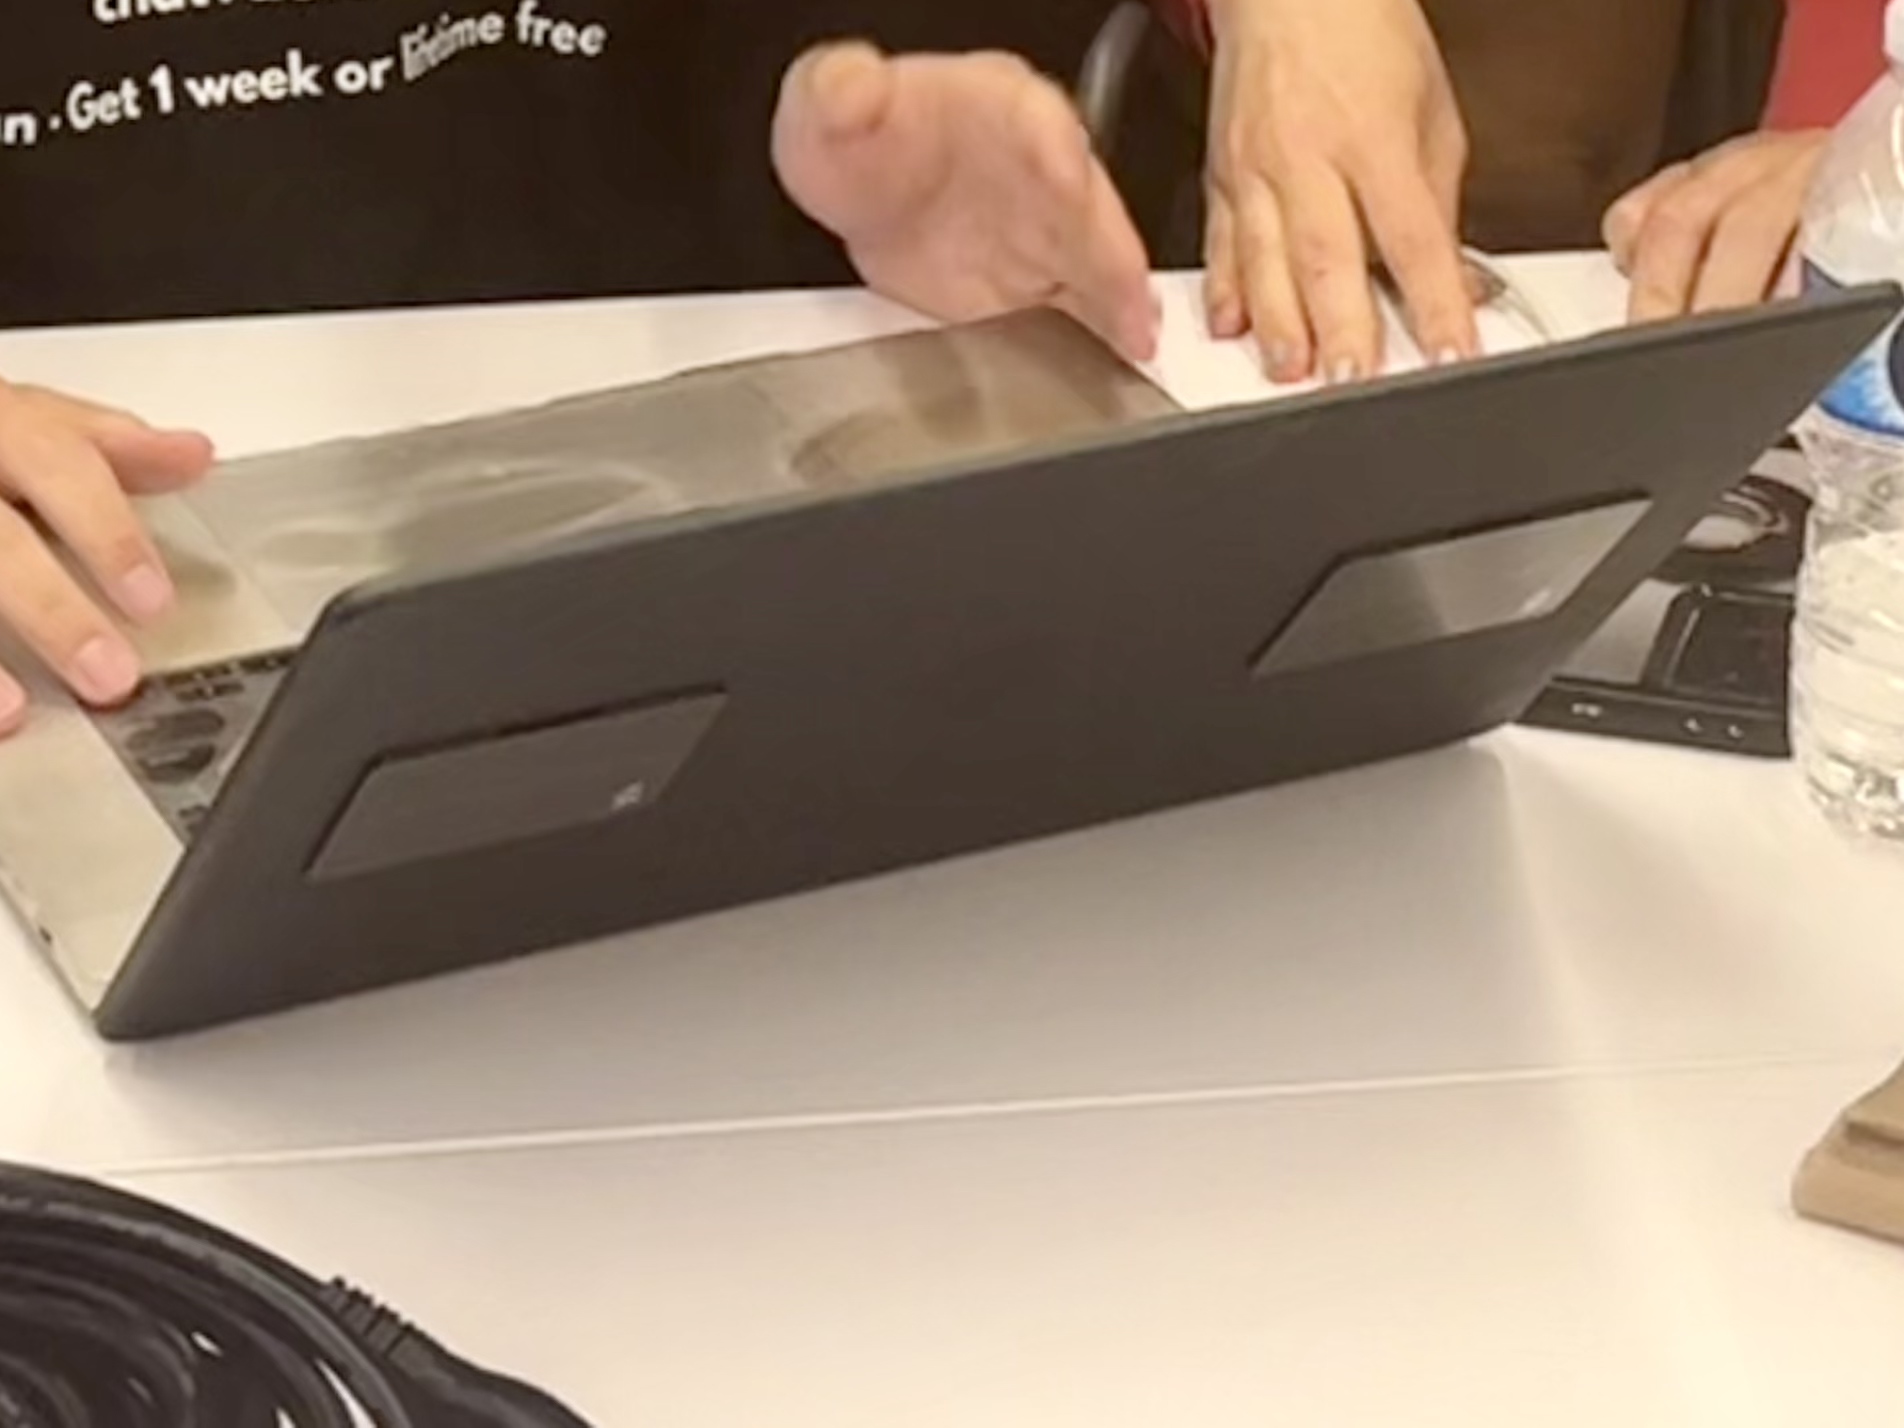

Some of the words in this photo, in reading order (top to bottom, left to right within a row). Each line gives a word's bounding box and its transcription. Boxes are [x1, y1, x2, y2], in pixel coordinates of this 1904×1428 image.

[66, 69, 141, 132] Get
[149, 67, 173, 114] 1
[184, 50, 323, 113] week
[334, 50, 394, 95] or
